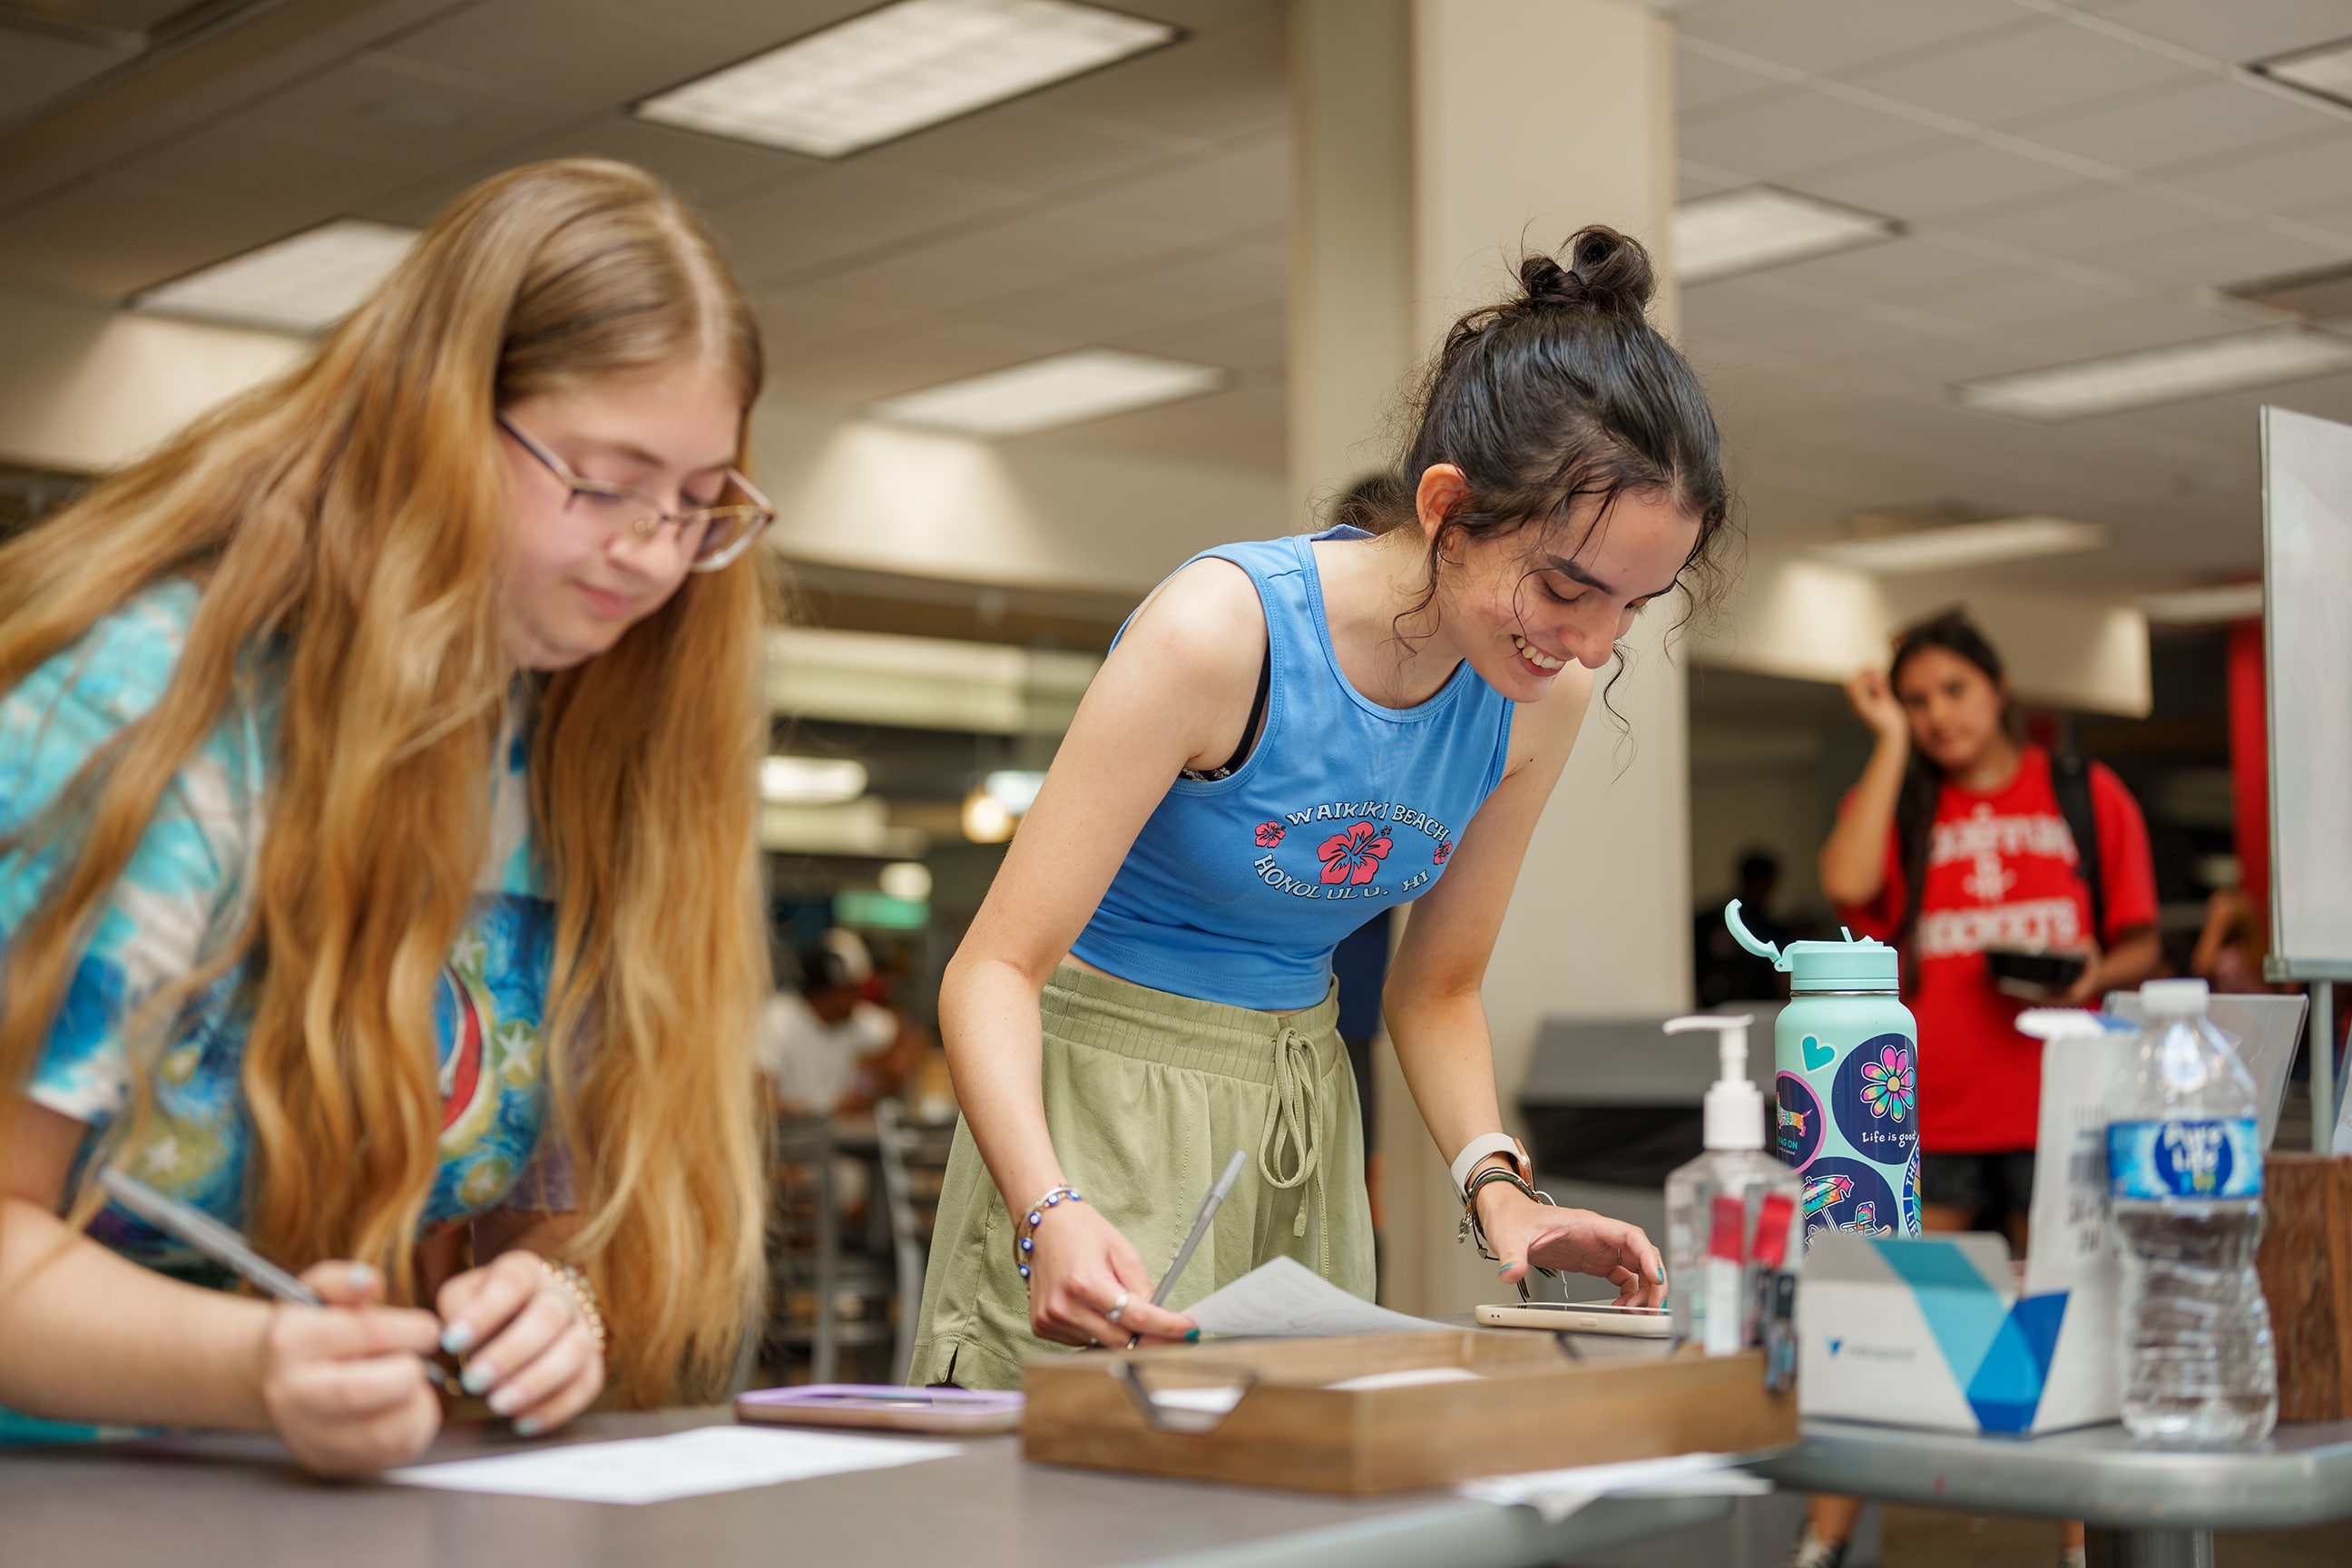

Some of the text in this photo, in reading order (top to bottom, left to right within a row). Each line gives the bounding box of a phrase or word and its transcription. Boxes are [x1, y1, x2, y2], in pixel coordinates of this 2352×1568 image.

[1286, 801, 1450, 842] WAIKIKI BEACH
[1402, 869, 1429, 893] HI
[1788, 1139, 1798, 1150] ON
[1862, 1131, 1886, 1143] Life
[1887, 1132, 1896, 1142] is
[1906, 1158, 1917, 1186] THE
